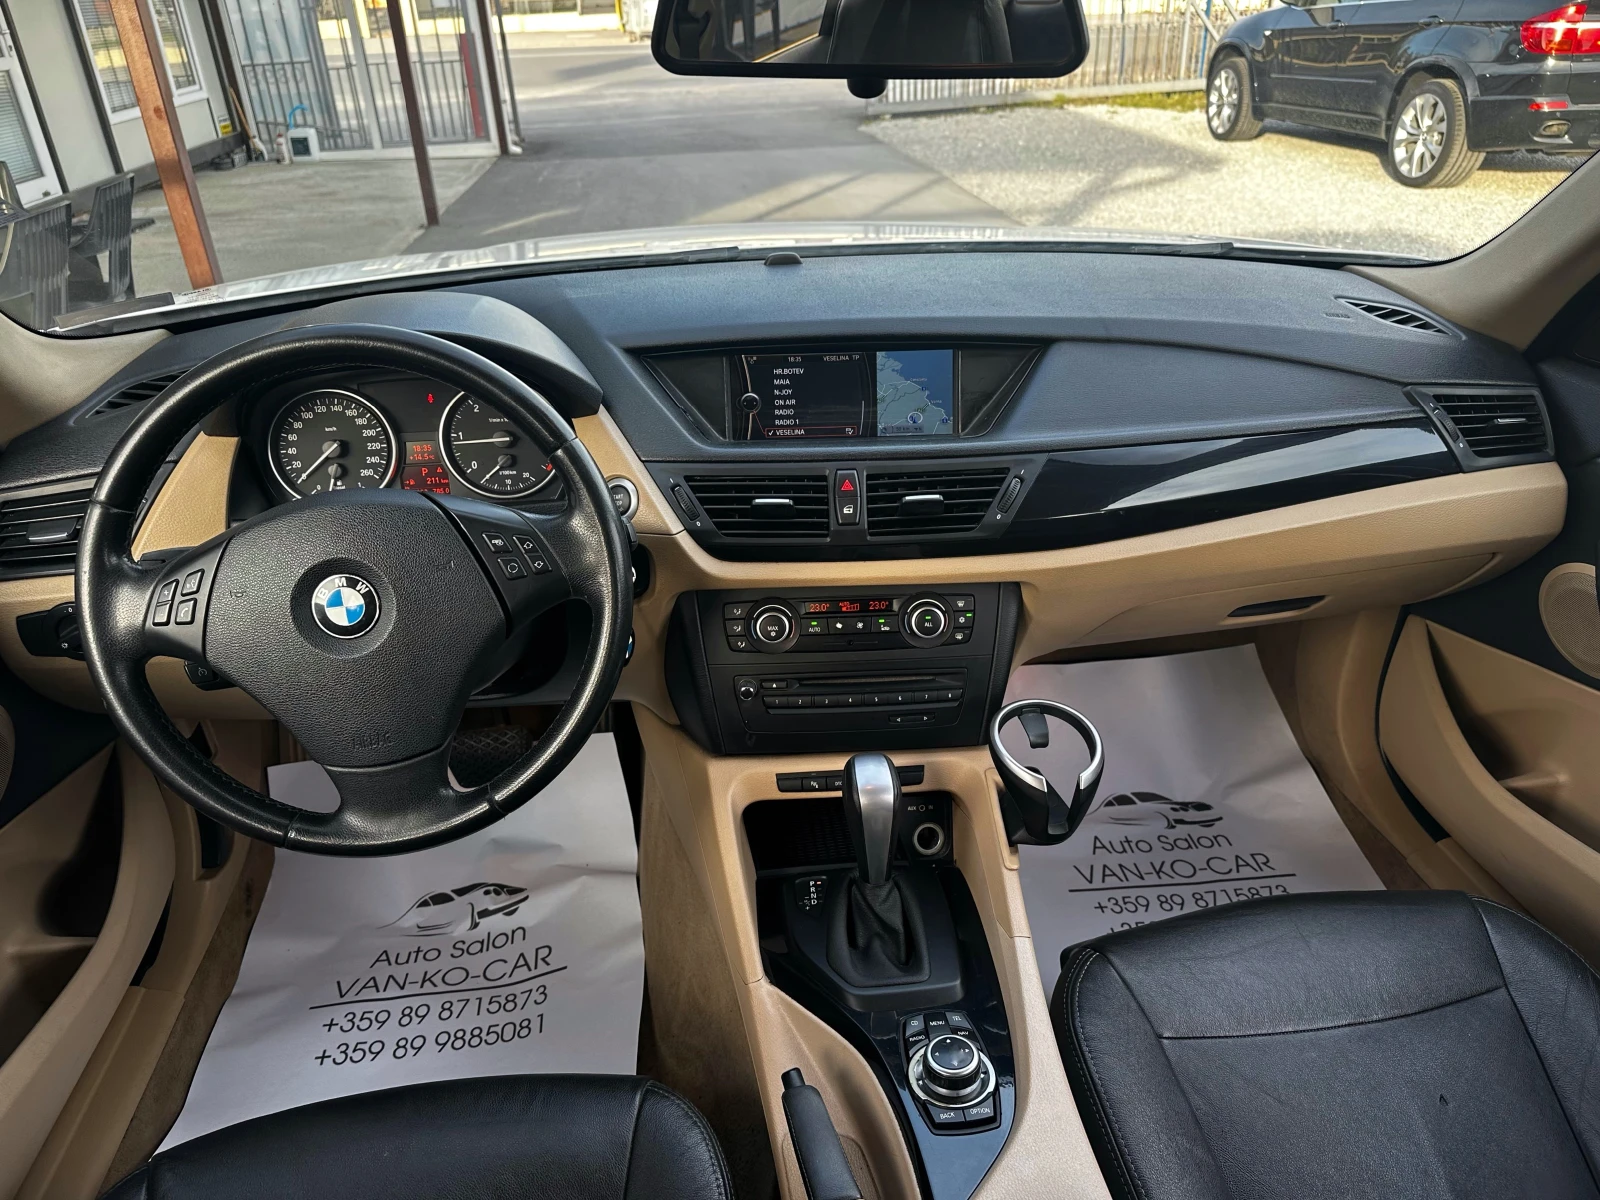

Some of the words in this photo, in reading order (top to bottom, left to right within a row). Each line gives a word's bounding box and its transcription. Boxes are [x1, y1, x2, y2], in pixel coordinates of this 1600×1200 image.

[459, 432, 462, 440] 1
[422, 468, 428, 476] P
[472, 461, 477, 469] 0
[317, 577, 369, 598] BMW
[1092, 836, 1153, 855] Auto
[1157, 833, 1232, 852] Salon
[1073, 853, 1276, 884] VAN-KO-CAR
[1094, 896, 1150, 914] +359
[1157, 894, 1185, 912] 89
[370, 946, 442, 968] Auto
[450, 926, 526, 958] Salon
[336, 945, 552, 999] VAN-KO-CAR
[322, 1010, 391, 1033] +359
[398, 1004, 430, 1027] 89
[438, 985, 548, 1021] 8715873
[314, 1040, 385, 1066] +359
[392, 1035, 427, 1059] 89
[435, 1013, 544, 1052] 9885081
